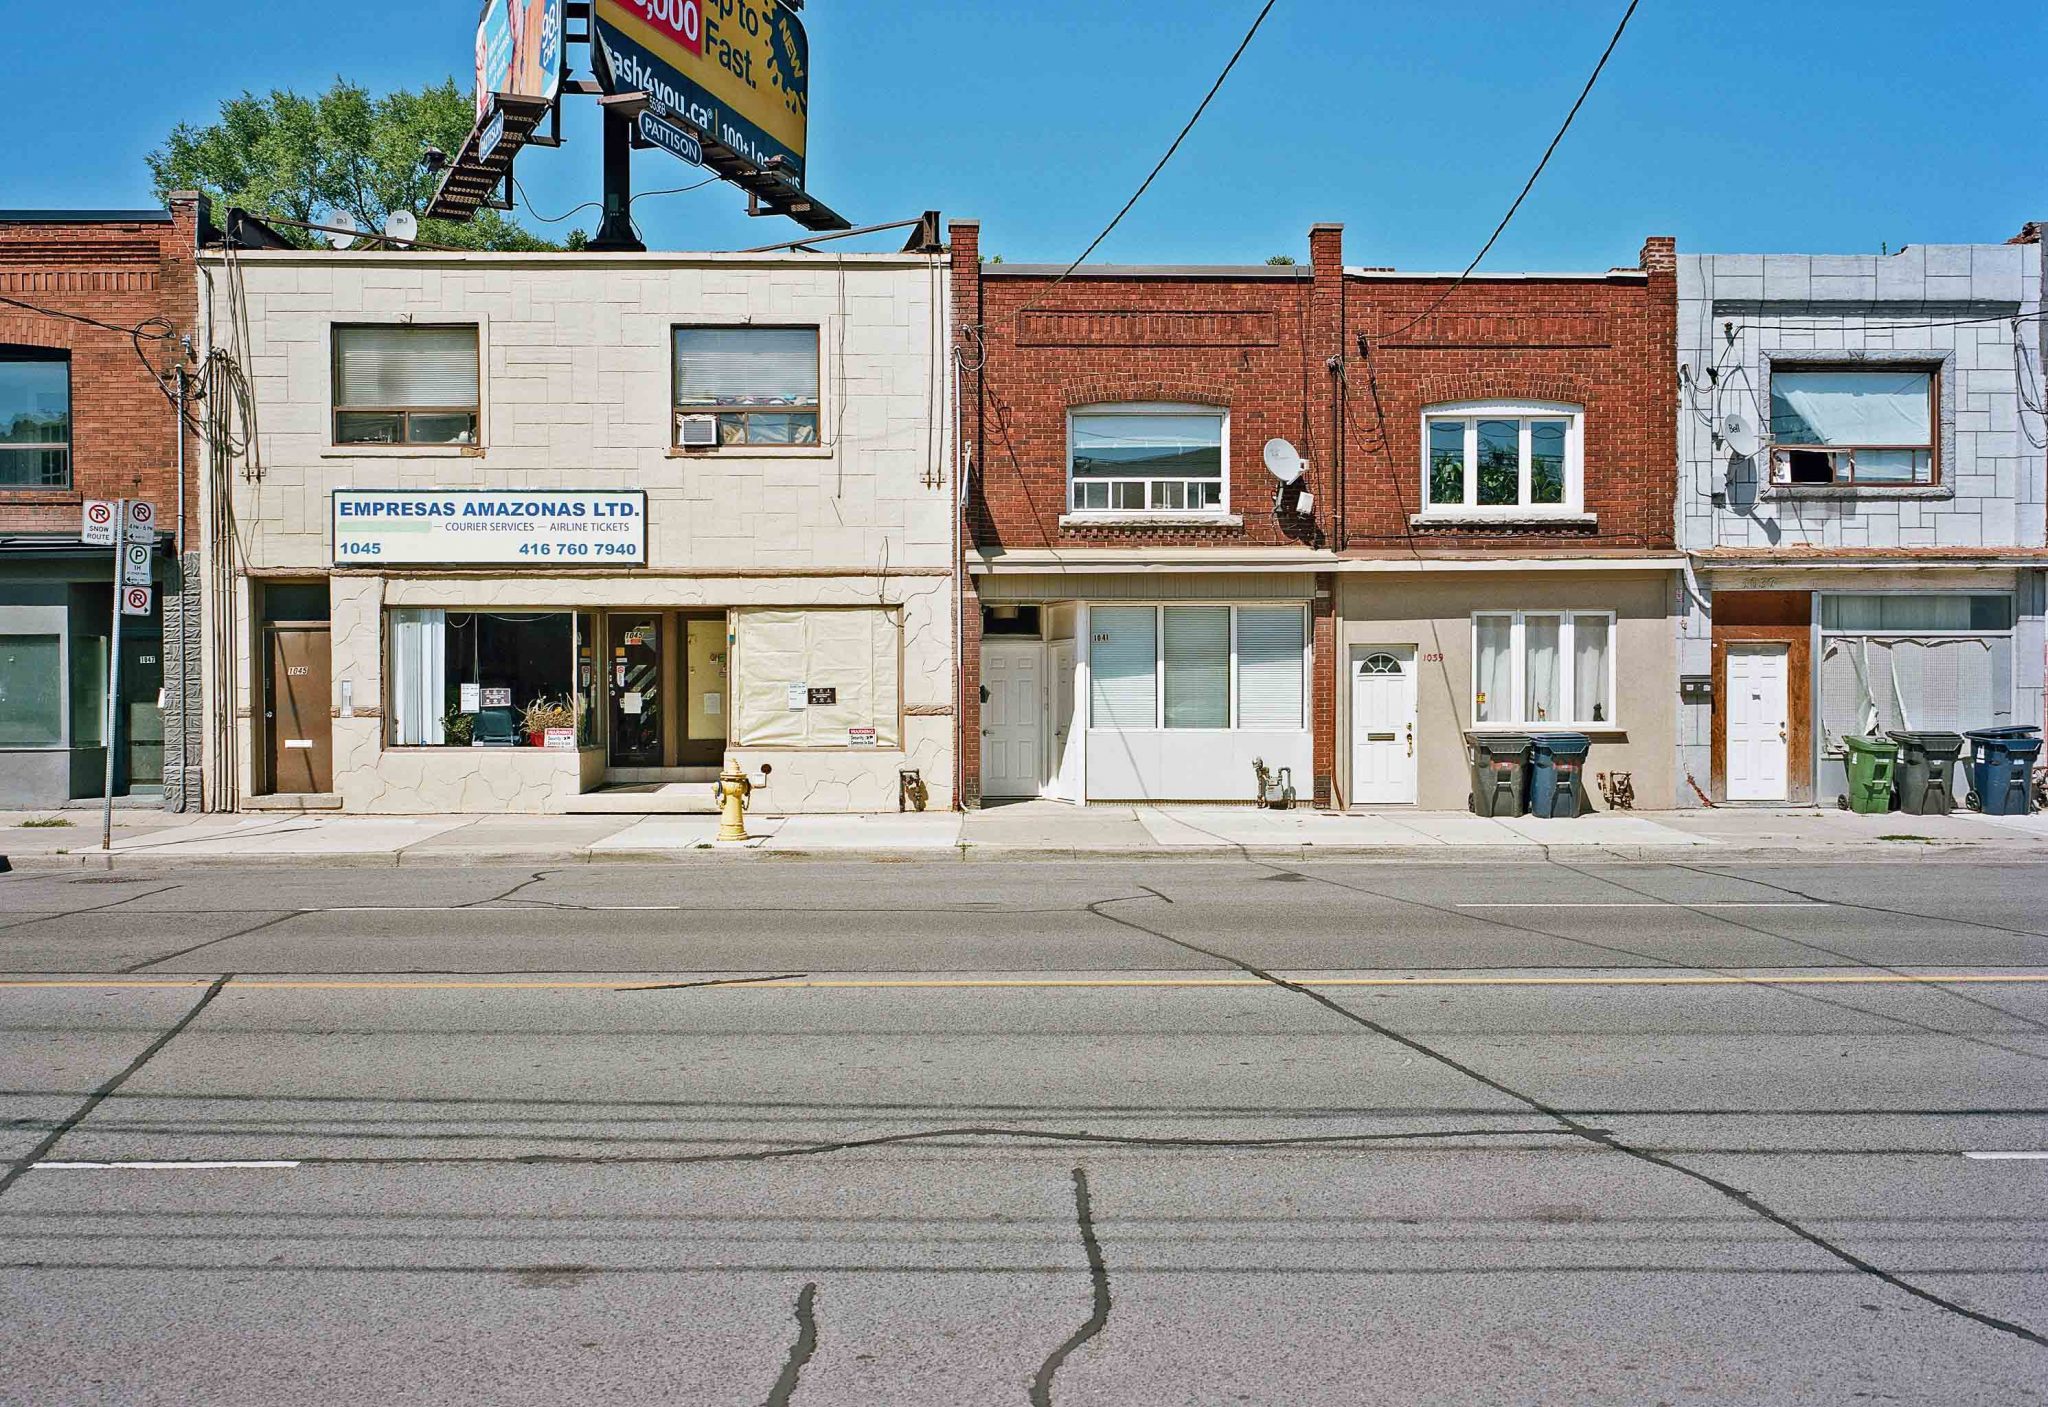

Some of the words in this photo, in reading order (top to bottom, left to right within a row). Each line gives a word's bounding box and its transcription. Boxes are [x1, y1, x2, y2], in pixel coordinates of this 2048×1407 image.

[633, 0, 699, 42] ,000
[705, 16, 757, 90] Fast.
[779, 17, 804, 77] NEW
[645, 117, 698, 161] PATTISON
[723, 123, 750, 155] 100+
[1728, 423, 1741, 433] Bell
[340, 502, 456, 516] EMPRESAS
[462, 502, 586, 517] AMAZONAS
[594, 502, 640, 517] LTD.
[89, 525, 109, 533] SNOW
[445, 522, 487, 531] COURIER
[490, 522, 535, 532] SERVICES
[550, 523, 588, 532] AIRLINE
[591, 523, 630, 532] TICKETS
[86, 533, 110, 541] ROUTE
[340, 542, 381, 555] 1045
[519, 543, 551, 555] 416
[556, 543, 588, 555] 760
[594, 543, 636, 555] 7940
[1423, 653, 1443, 662] 1039
[288, 667, 308, 675] 1045
